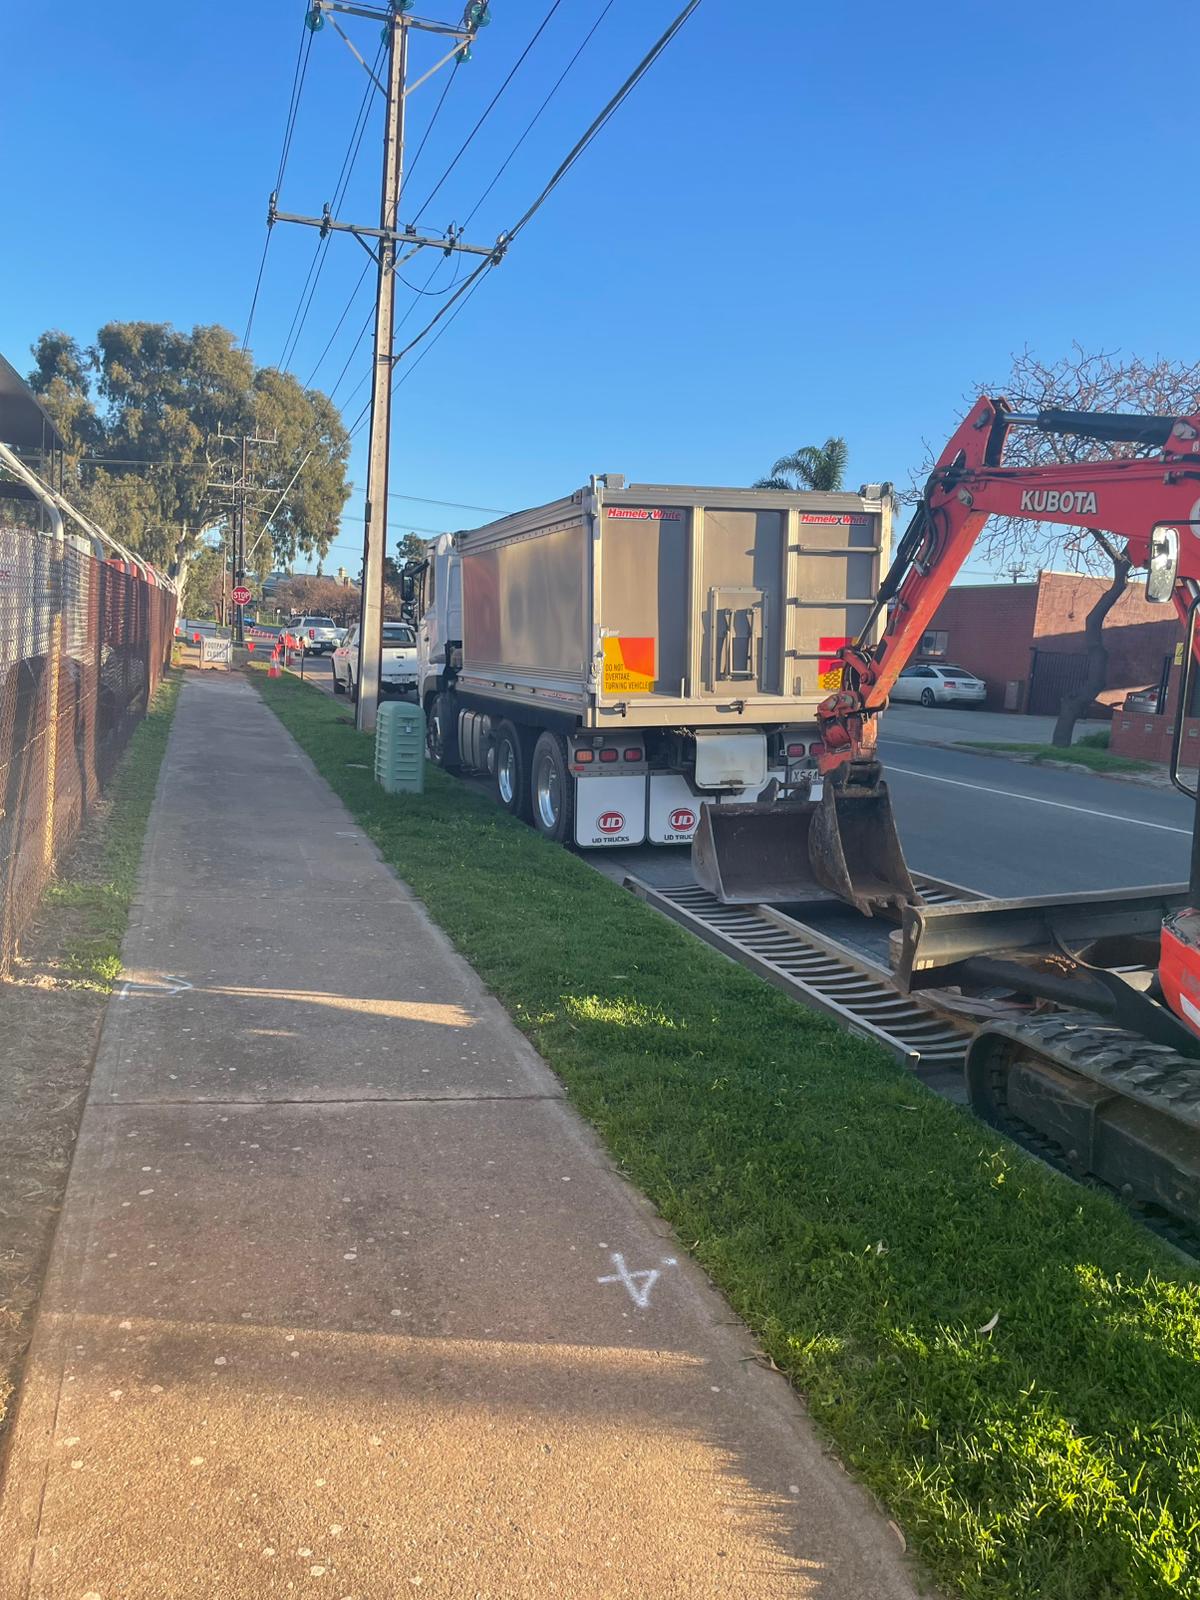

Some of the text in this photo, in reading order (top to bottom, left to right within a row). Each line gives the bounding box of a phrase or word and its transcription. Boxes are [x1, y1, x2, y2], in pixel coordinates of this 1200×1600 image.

[1020, 490, 1097, 514] KUBOTA
[233, 591, 250, 599] STOP
[605, 663, 624, 672] DO NOT
[605, 672, 630, 681] OVERTAKE
[605, 681, 627, 690] TURNING
[600, 817, 623, 828] UD
[671, 815, 694, 826] UD
[603, 835, 630, 843] TRUCKS
[675, 833, 694, 841] TRUC
